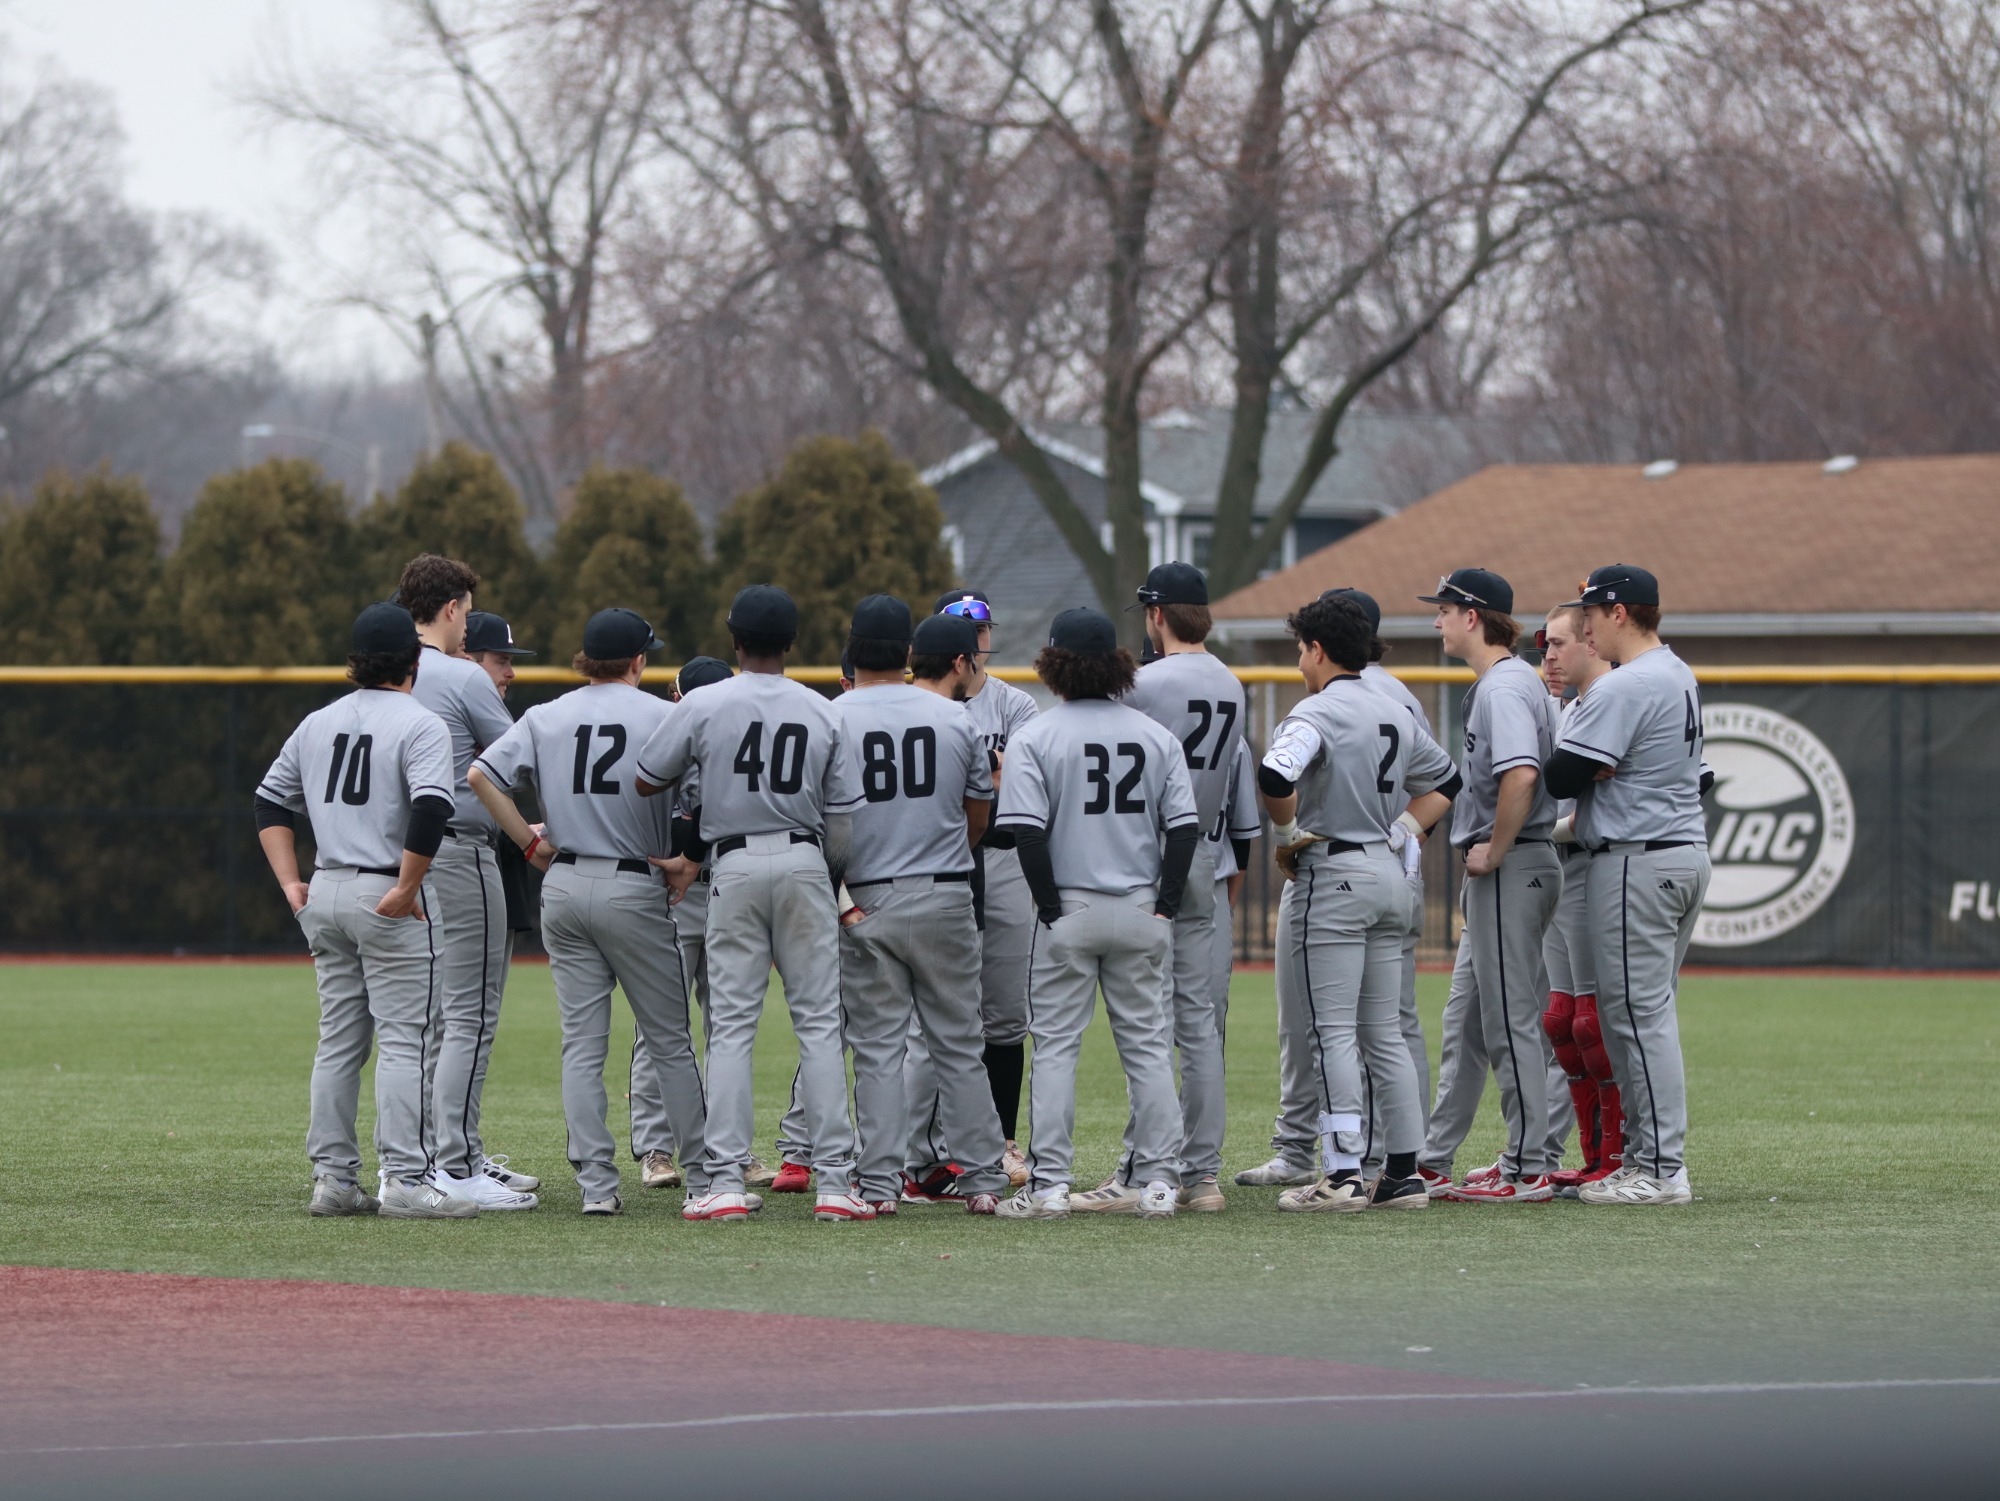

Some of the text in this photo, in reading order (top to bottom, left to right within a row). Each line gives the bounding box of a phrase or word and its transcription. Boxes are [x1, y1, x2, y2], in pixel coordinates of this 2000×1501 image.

[324, 732, 373, 806] 10
[573, 723, 627, 795] 12
[733, 721, 809, 795] 40
[863, 725, 936, 803] 80
[1183, 700, 1237, 770] 27
[1377, 724, 1399, 793] 2
[1084, 743, 1146, 815] 32
[1704, 712, 1847, 842] INTERCOLLEGIATE
[1703, 811, 1816, 862] IAC
[1704, 864, 1834, 937] CONFERENCE
[1948, 881, 2000, 921] FL
